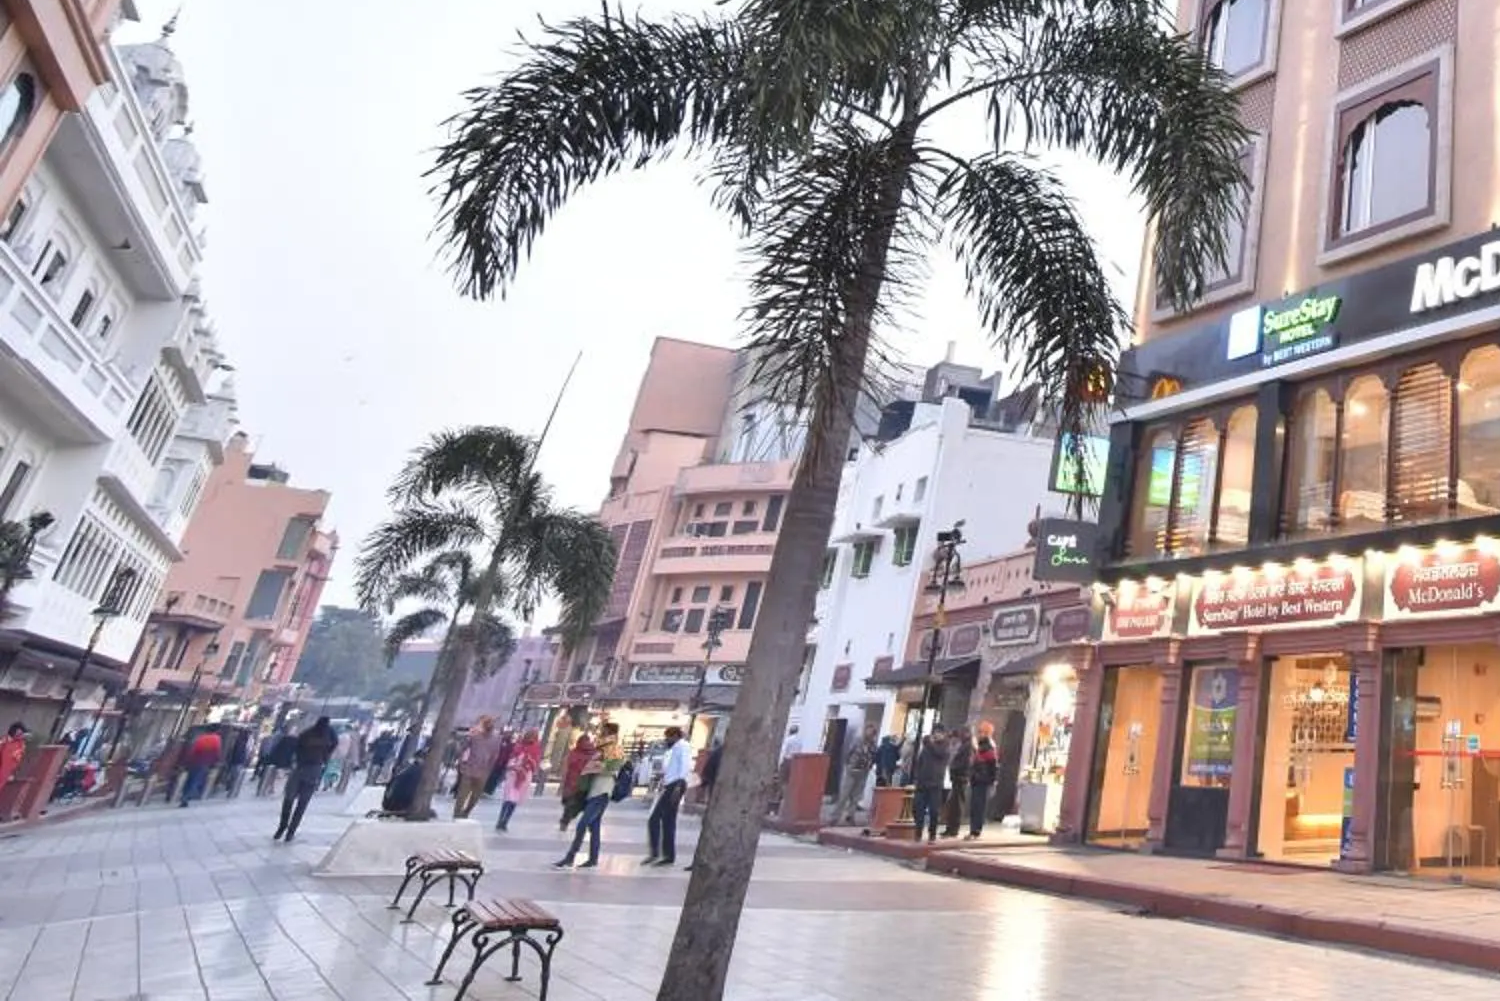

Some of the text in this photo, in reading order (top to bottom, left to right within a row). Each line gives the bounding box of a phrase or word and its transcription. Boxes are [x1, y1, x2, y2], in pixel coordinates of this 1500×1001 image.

[1408, 582, 1485, 604] McDonald's
[1242, 602, 1267, 619] Hotel
[1280, 599, 1302, 616] Best
